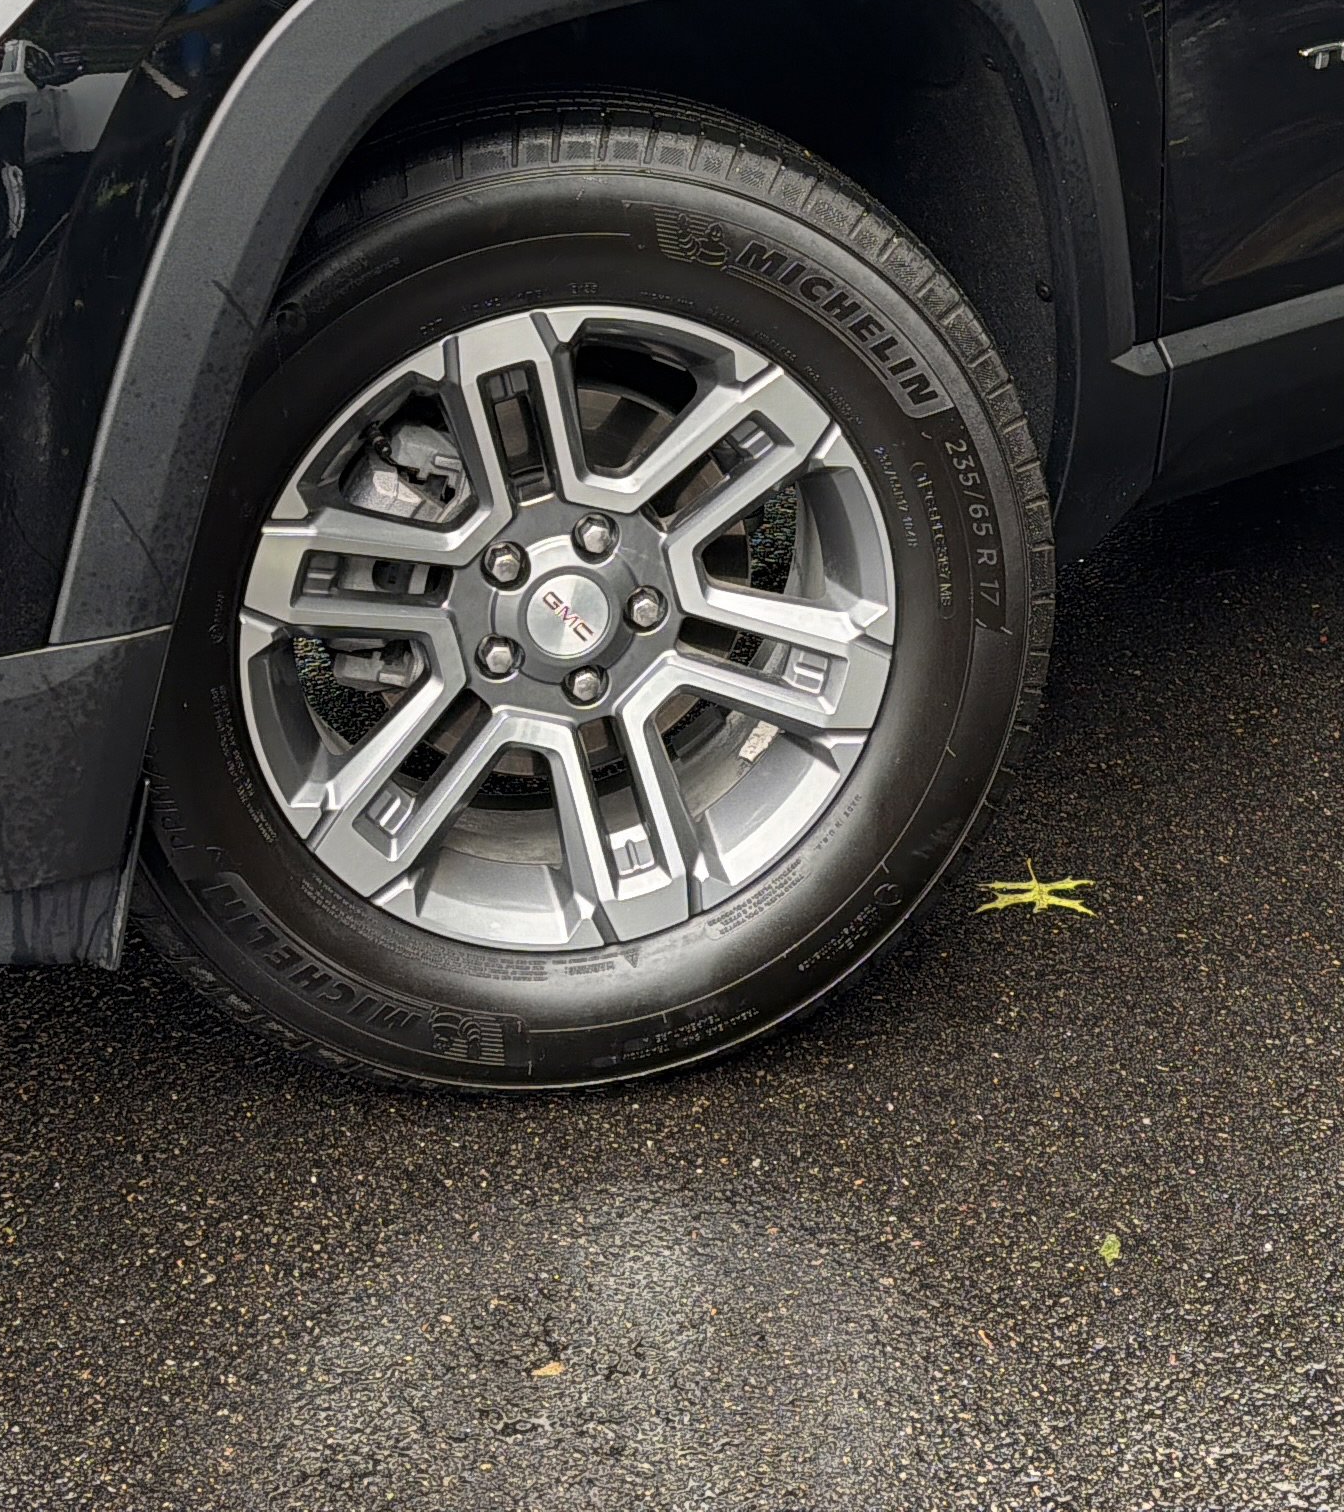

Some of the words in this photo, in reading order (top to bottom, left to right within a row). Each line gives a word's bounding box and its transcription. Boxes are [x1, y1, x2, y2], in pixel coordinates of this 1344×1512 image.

[735, 240, 939, 406] MICHELIN
[945, 439, 994, 536] 235/65
[977, 548, 997, 565] R
[979, 579, 1000, 606] 17
[543, 591, 594, 642] GMC
[204, 883, 424, 1030] MICHELIN
